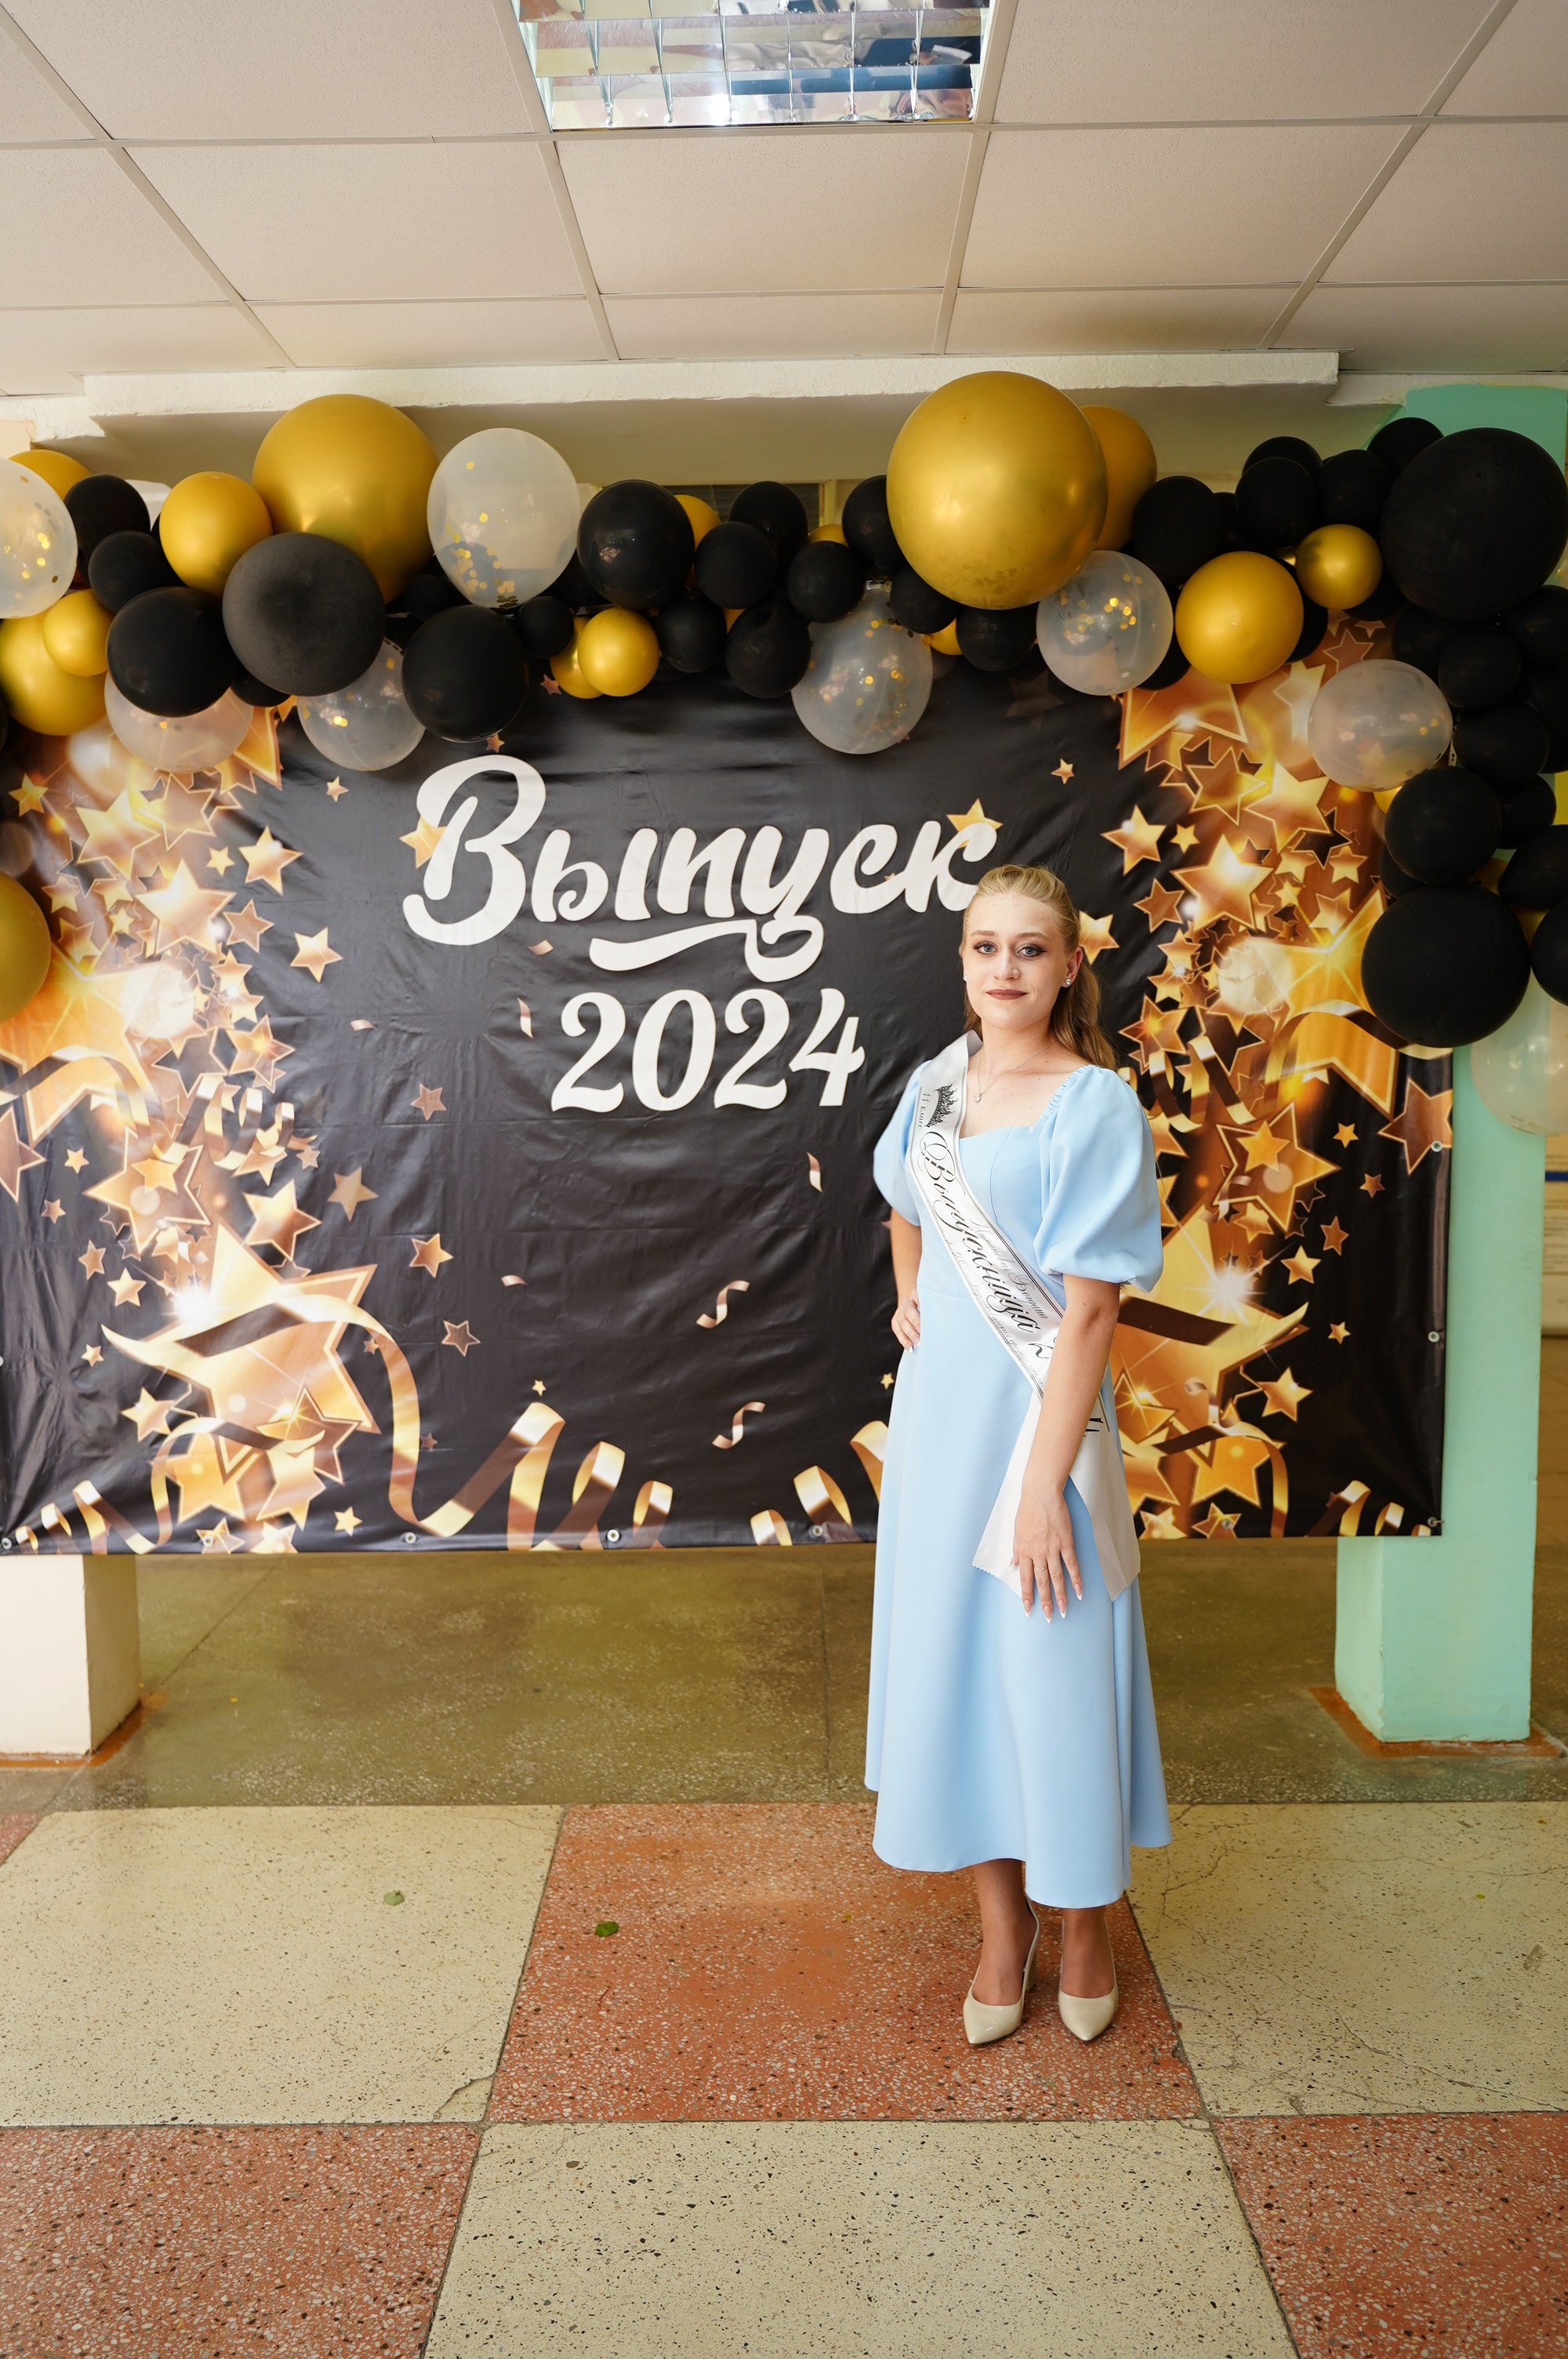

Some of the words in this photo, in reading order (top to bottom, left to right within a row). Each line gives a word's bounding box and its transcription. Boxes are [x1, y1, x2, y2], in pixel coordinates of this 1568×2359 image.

[403, 755, 997, 983] Выпуск
[551, 988, 866, 1113] 2024
[922, 1093, 931, 1102] 11
[916, 1131, 1041, 1333] Выпускница
